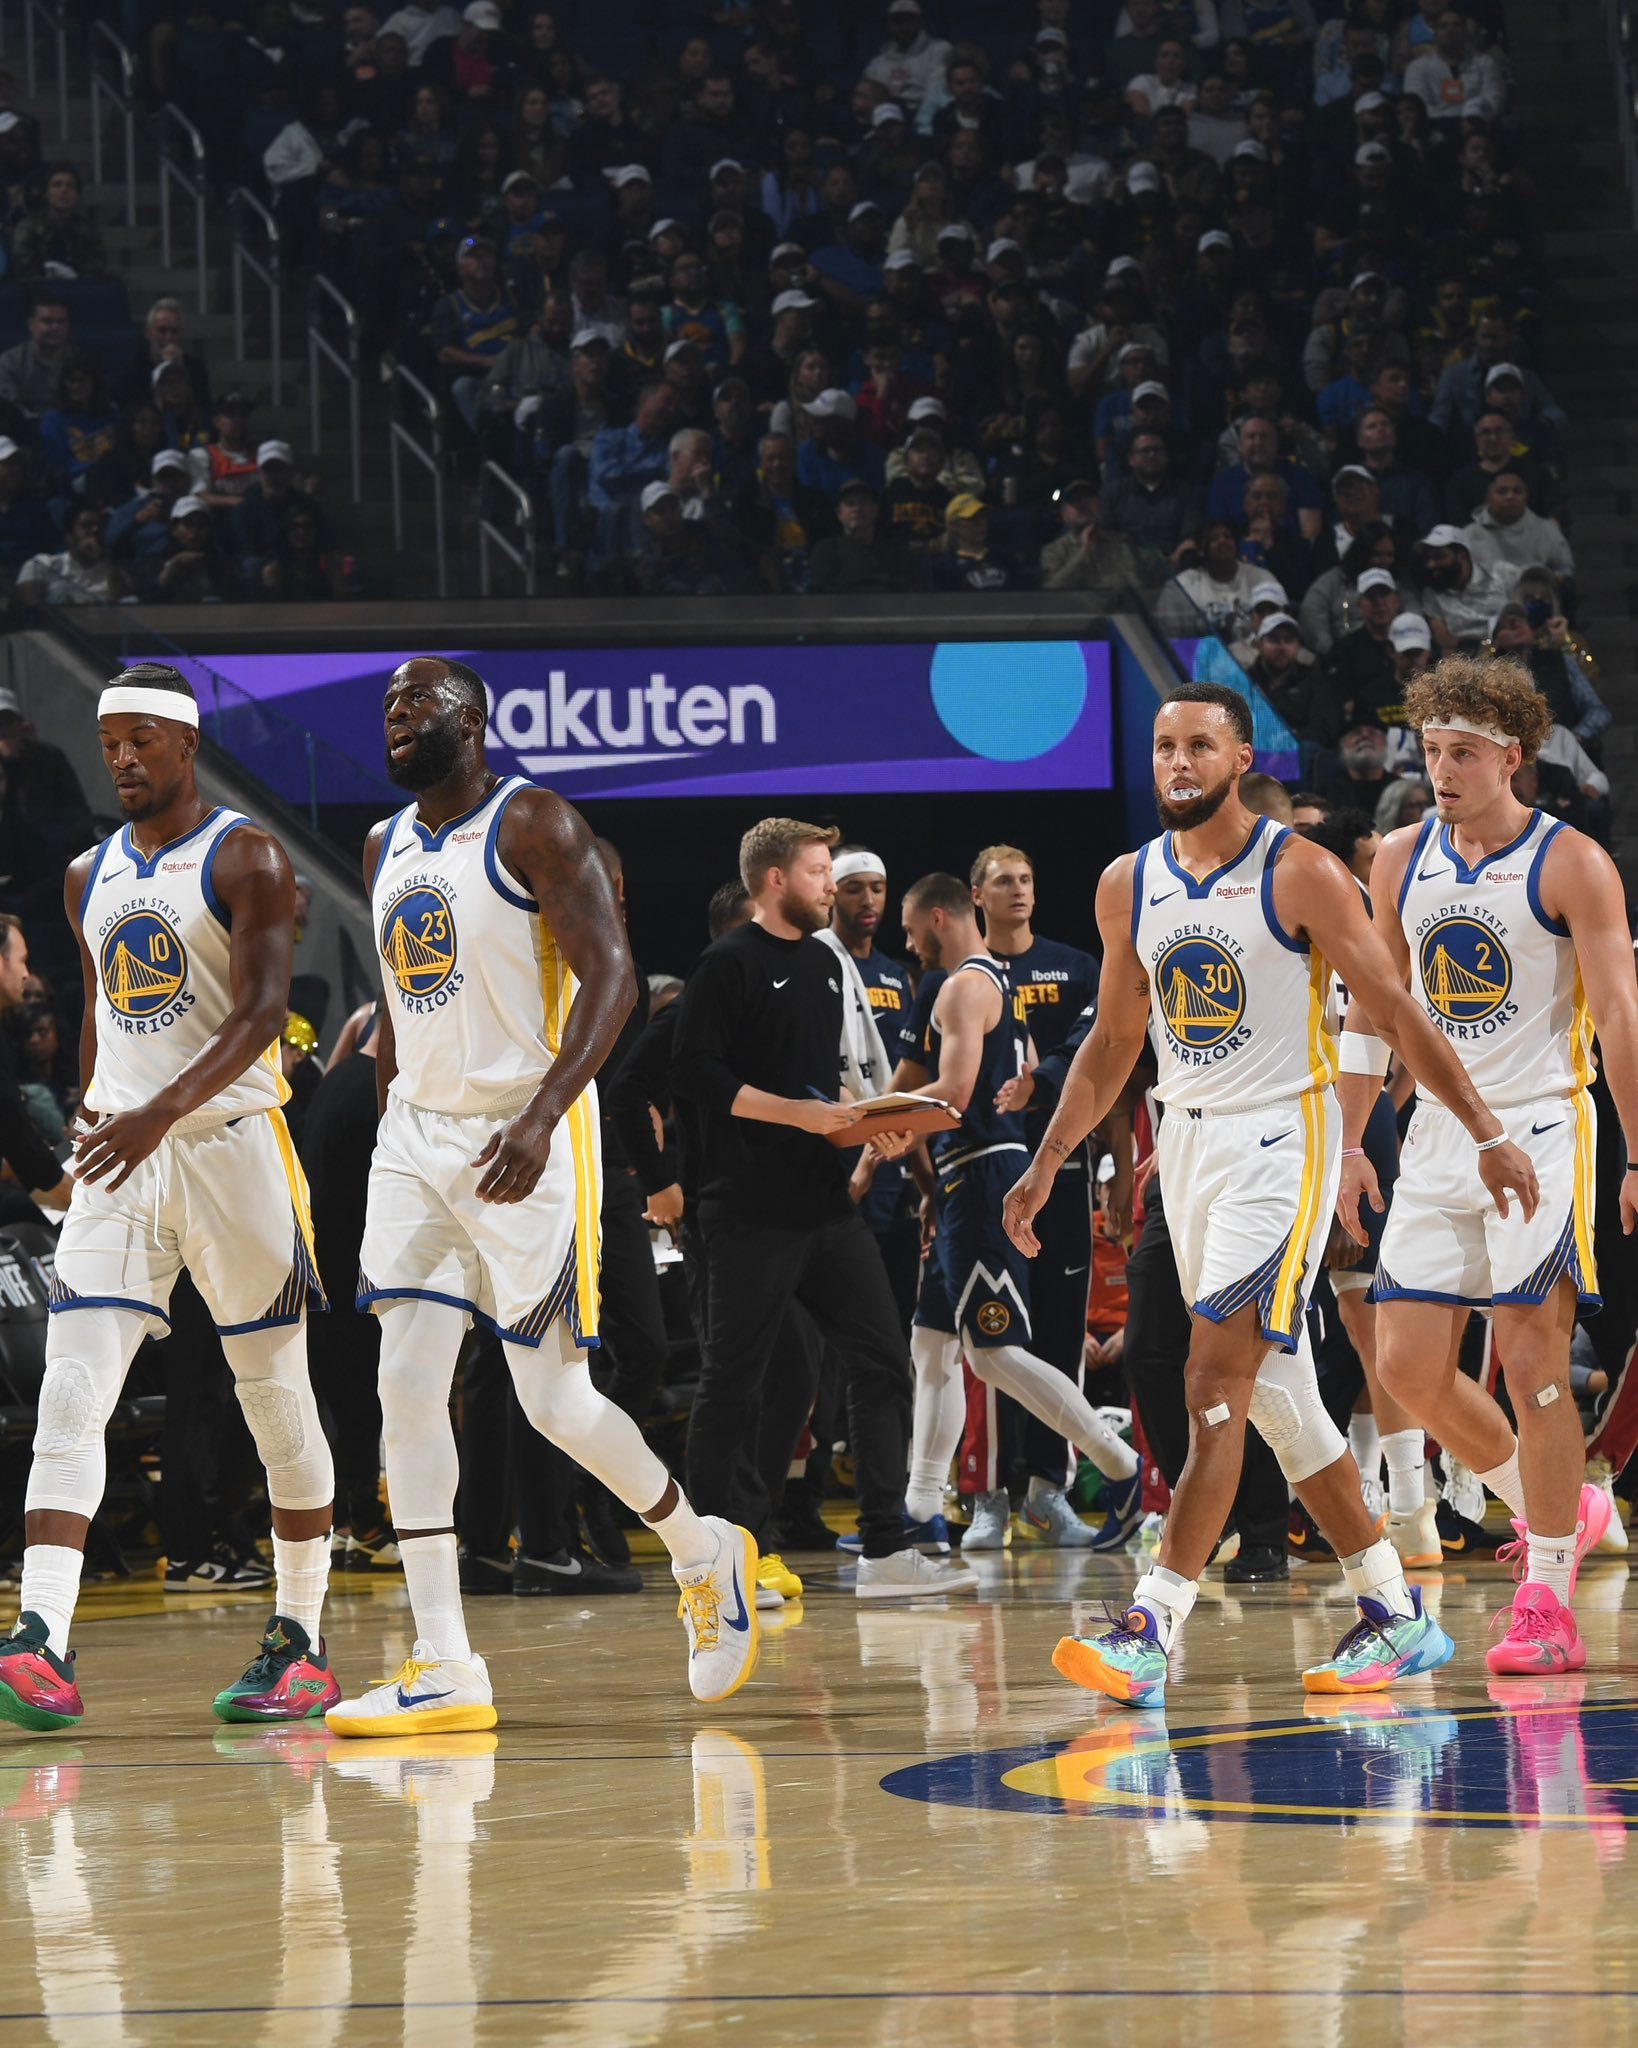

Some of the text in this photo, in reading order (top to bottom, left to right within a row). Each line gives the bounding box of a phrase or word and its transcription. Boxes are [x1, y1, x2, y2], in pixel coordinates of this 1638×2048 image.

[162, 862, 197, 872] Rakuten
[1486, 872, 1524, 881] Rakuten
[381, 873, 458, 912] GOLDEN STATE
[1216, 885, 1256, 897] Rakuten
[98, 897, 182, 937] GOLDEN STATE
[420, 910, 447, 943] 23
[1416, 903, 1509, 938] GOLDEN STATE
[149, 932, 171, 963] 10
[1151, 923, 1245, 962] GOLDEN STATE
[1475, 942, 1493, 971] 2
[1031, 970, 1069, 981] ibotta
[1200, 964, 1232, 994] 30
[109, 990, 196, 1035] WARRIORS
[866, 986, 902, 1010] GETS
[1426, 1000, 1519, 1040] WARRIORS
[1164, 1025, 1253, 1067] WARRIORS
